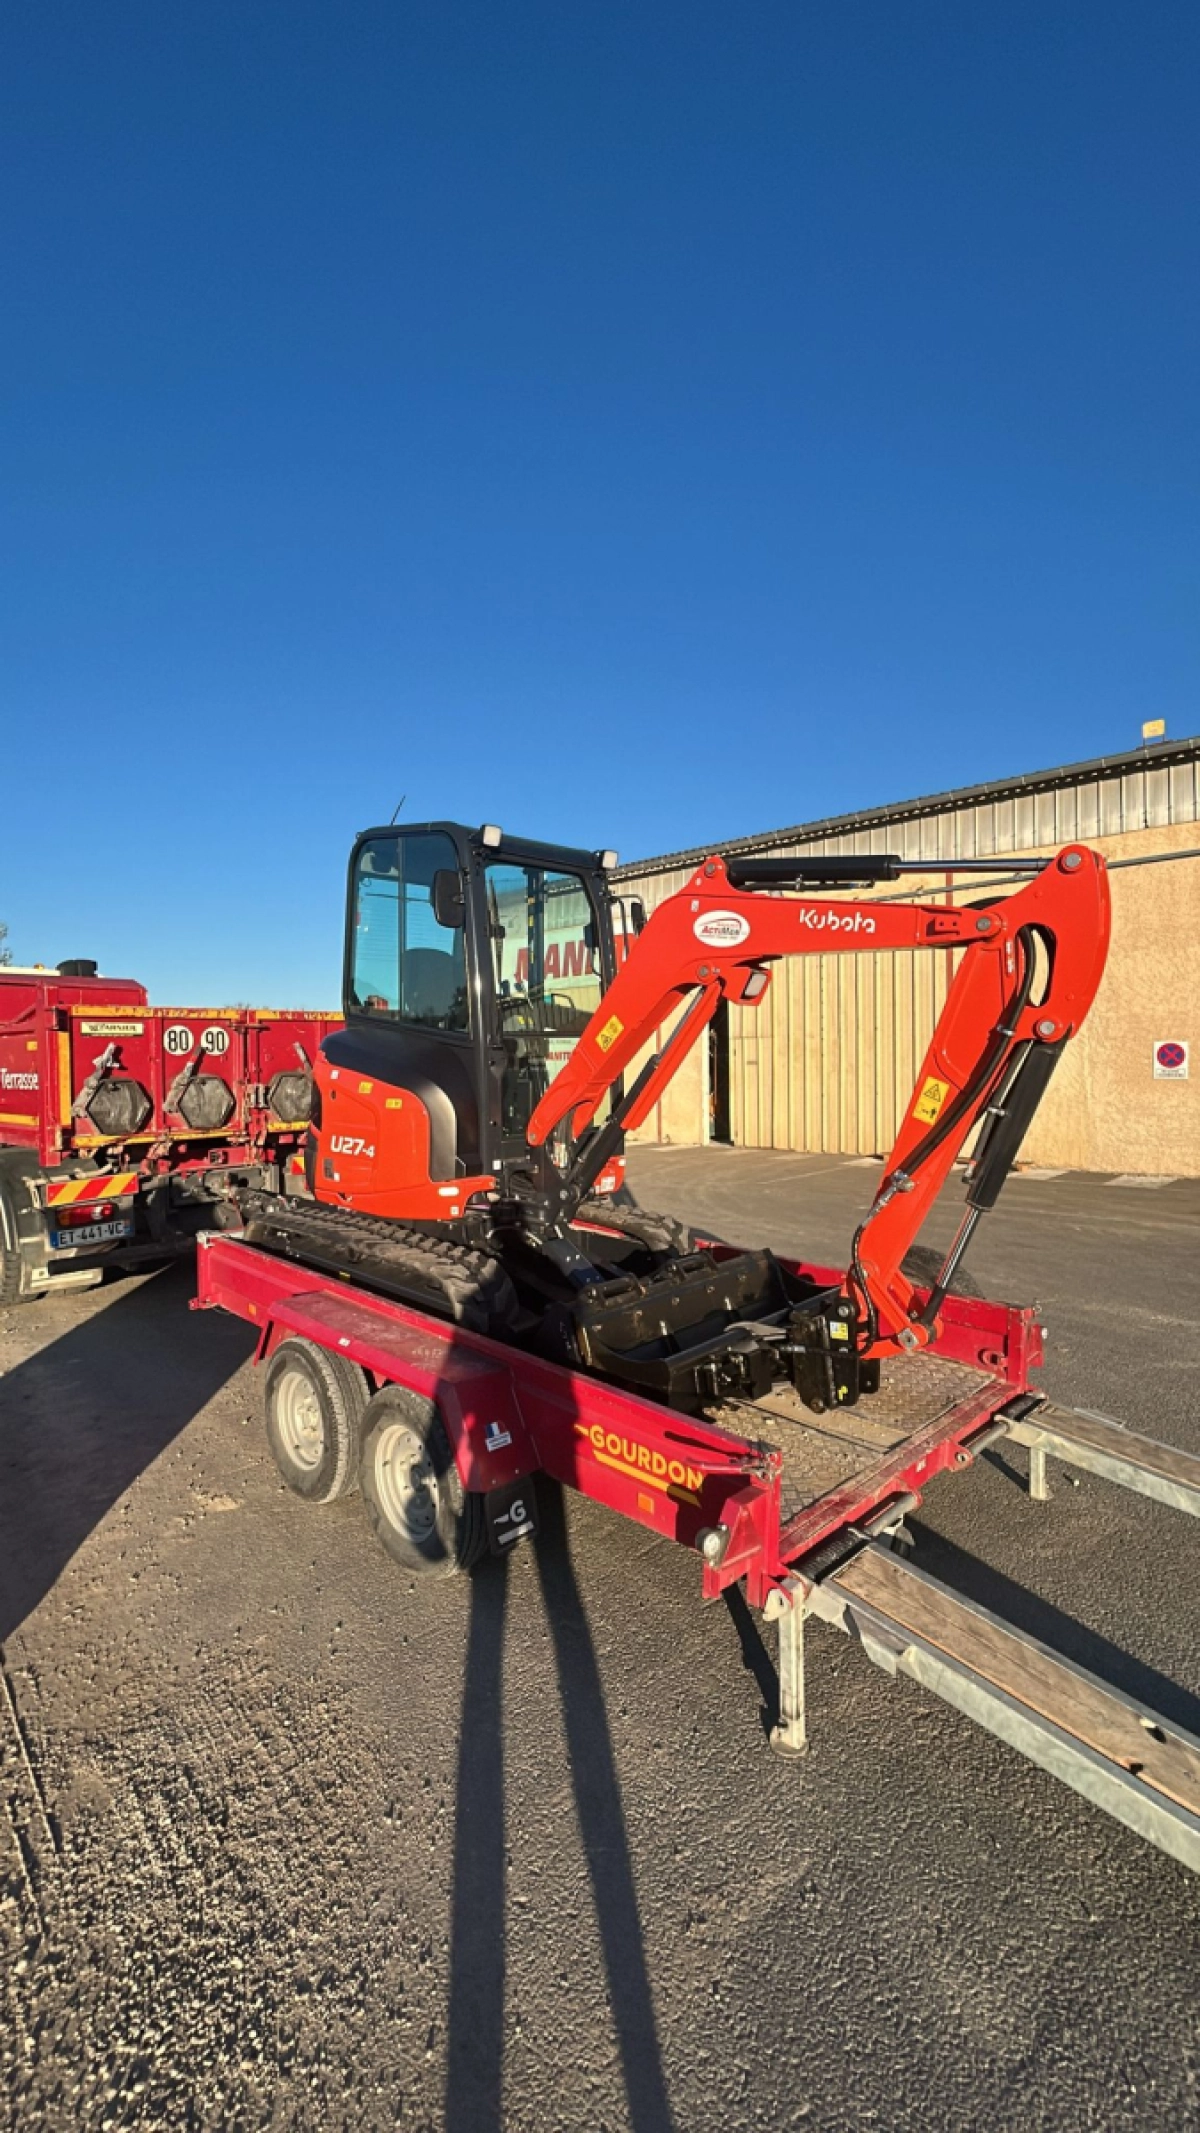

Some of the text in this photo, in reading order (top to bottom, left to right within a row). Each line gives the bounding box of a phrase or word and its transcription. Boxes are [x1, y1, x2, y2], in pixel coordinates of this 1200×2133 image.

[799, 908, 876, 934] Kubota
[167, 1029, 189, 1052] 80
[205, 1030, 226, 1052] 90
[330, 1134, 376, 1158] U27-4
[589, 1424, 703, 1492] GOURDON
